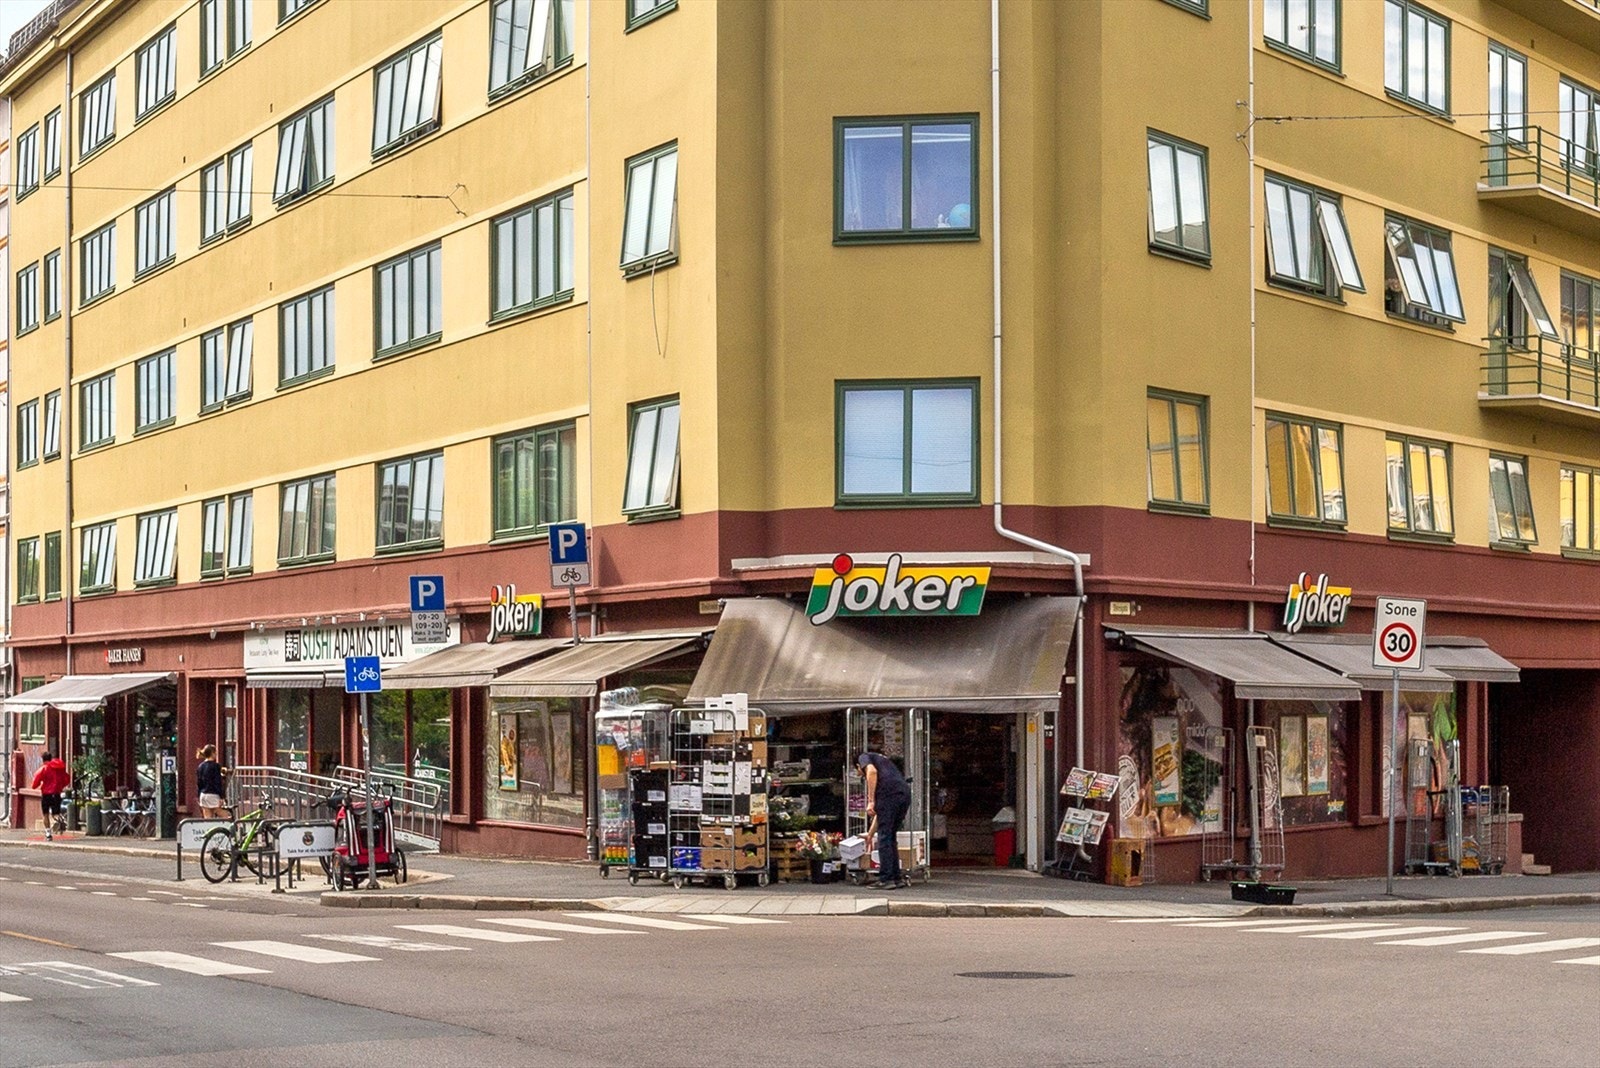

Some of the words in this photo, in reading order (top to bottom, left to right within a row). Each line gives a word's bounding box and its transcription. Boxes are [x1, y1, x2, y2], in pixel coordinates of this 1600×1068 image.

[558, 529, 578, 559] P
[418, 580, 436, 607] P
[810, 553, 976, 626] joker
[1287, 572, 1351, 635] joker
[487, 584, 536, 644] joker
[1385, 602, 1417, 617] Sone
[302, 629, 332, 660] SUSHI
[333, 624, 403, 660] ADAMSTUEN
[1387, 632, 1411, 653] 30
